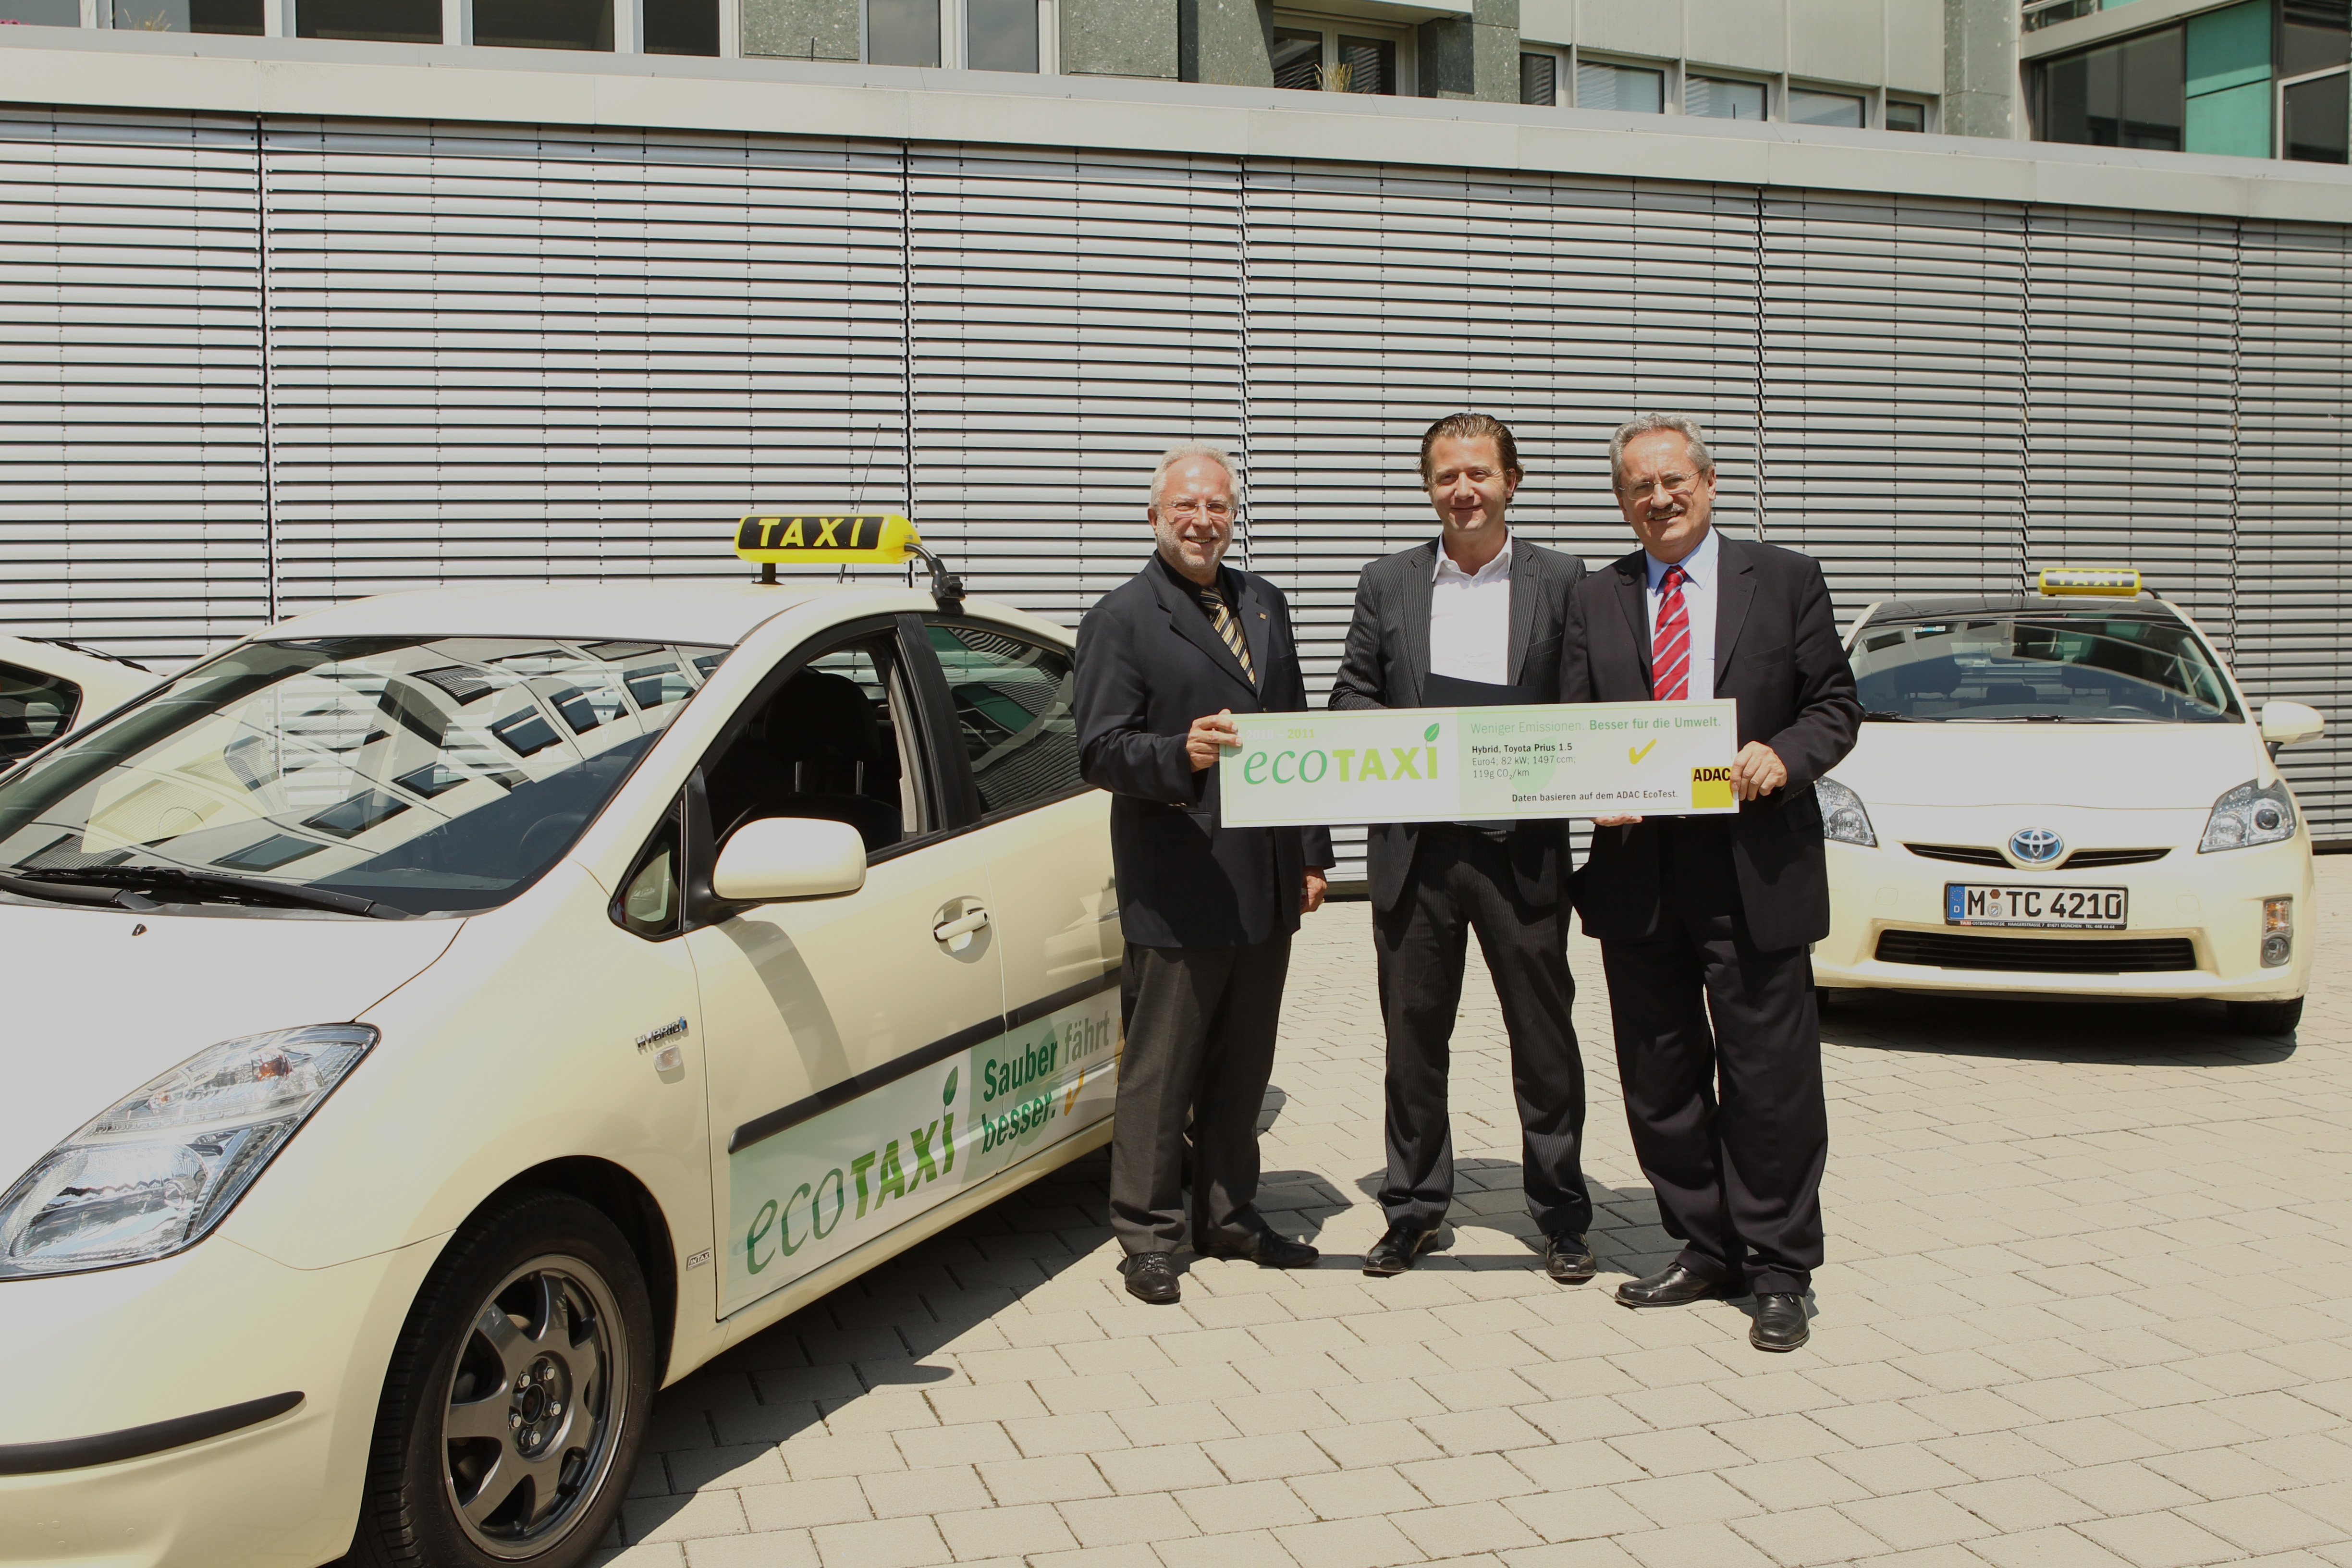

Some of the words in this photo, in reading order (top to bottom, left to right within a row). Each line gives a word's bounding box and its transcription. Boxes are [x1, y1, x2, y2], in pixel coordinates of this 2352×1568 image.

[758, 518, 864, 547] TAXI
[1470, 723, 1515, 736] Weniger
[1519, 721, 1585, 733] Emissionen.
[1589, 720, 1629, 730] Besser
[1632, 718, 1649, 729] für
[1653, 717, 1670, 728] die
[1674, 716, 1721, 728] Umwelt.
[1287, 728, 1315, 739] 2011
[1471, 745, 1501, 755] Hybrid,
[1504, 745, 1531, 754] Toyota
[1534, 744, 1556, 752] Prius
[1559, 743, 1572, 751] 1.5
[1472, 757, 1498, 766] Euro4;
[1501, 757, 1512, 765] 82
[1514, 756, 1530, 765] kW;
[1533, 755, 1555, 764] 1497
[1556, 756, 1576, 764] ccm;
[1472, 769, 1495, 779] 119g
[1693, 768, 1731, 782] ADAC
[1512, 794, 1537, 802] Daten
[1539, 792, 1577, 802] basieren
[1579, 791, 1593, 800] auf
[1595, 791, 1614, 800] dem
[1616, 790, 1640, 799] ADAC
[1643, 789, 1678, 799] EcoTest.
[1953, 905, 1960, 913] D
[1968, 890, 1985, 916] M
[2006, 891, 2042, 917] TC
[2050, 892, 2122, 919] 4210
[635, 1020, 682, 1048] HYBRID
[983, 1040, 1058, 1102] Sauber
[1064, 1009, 1110, 1066] fährt
[981, 1090, 1056, 1155] besser.
[690, 1252, 710, 1265] INTAX
